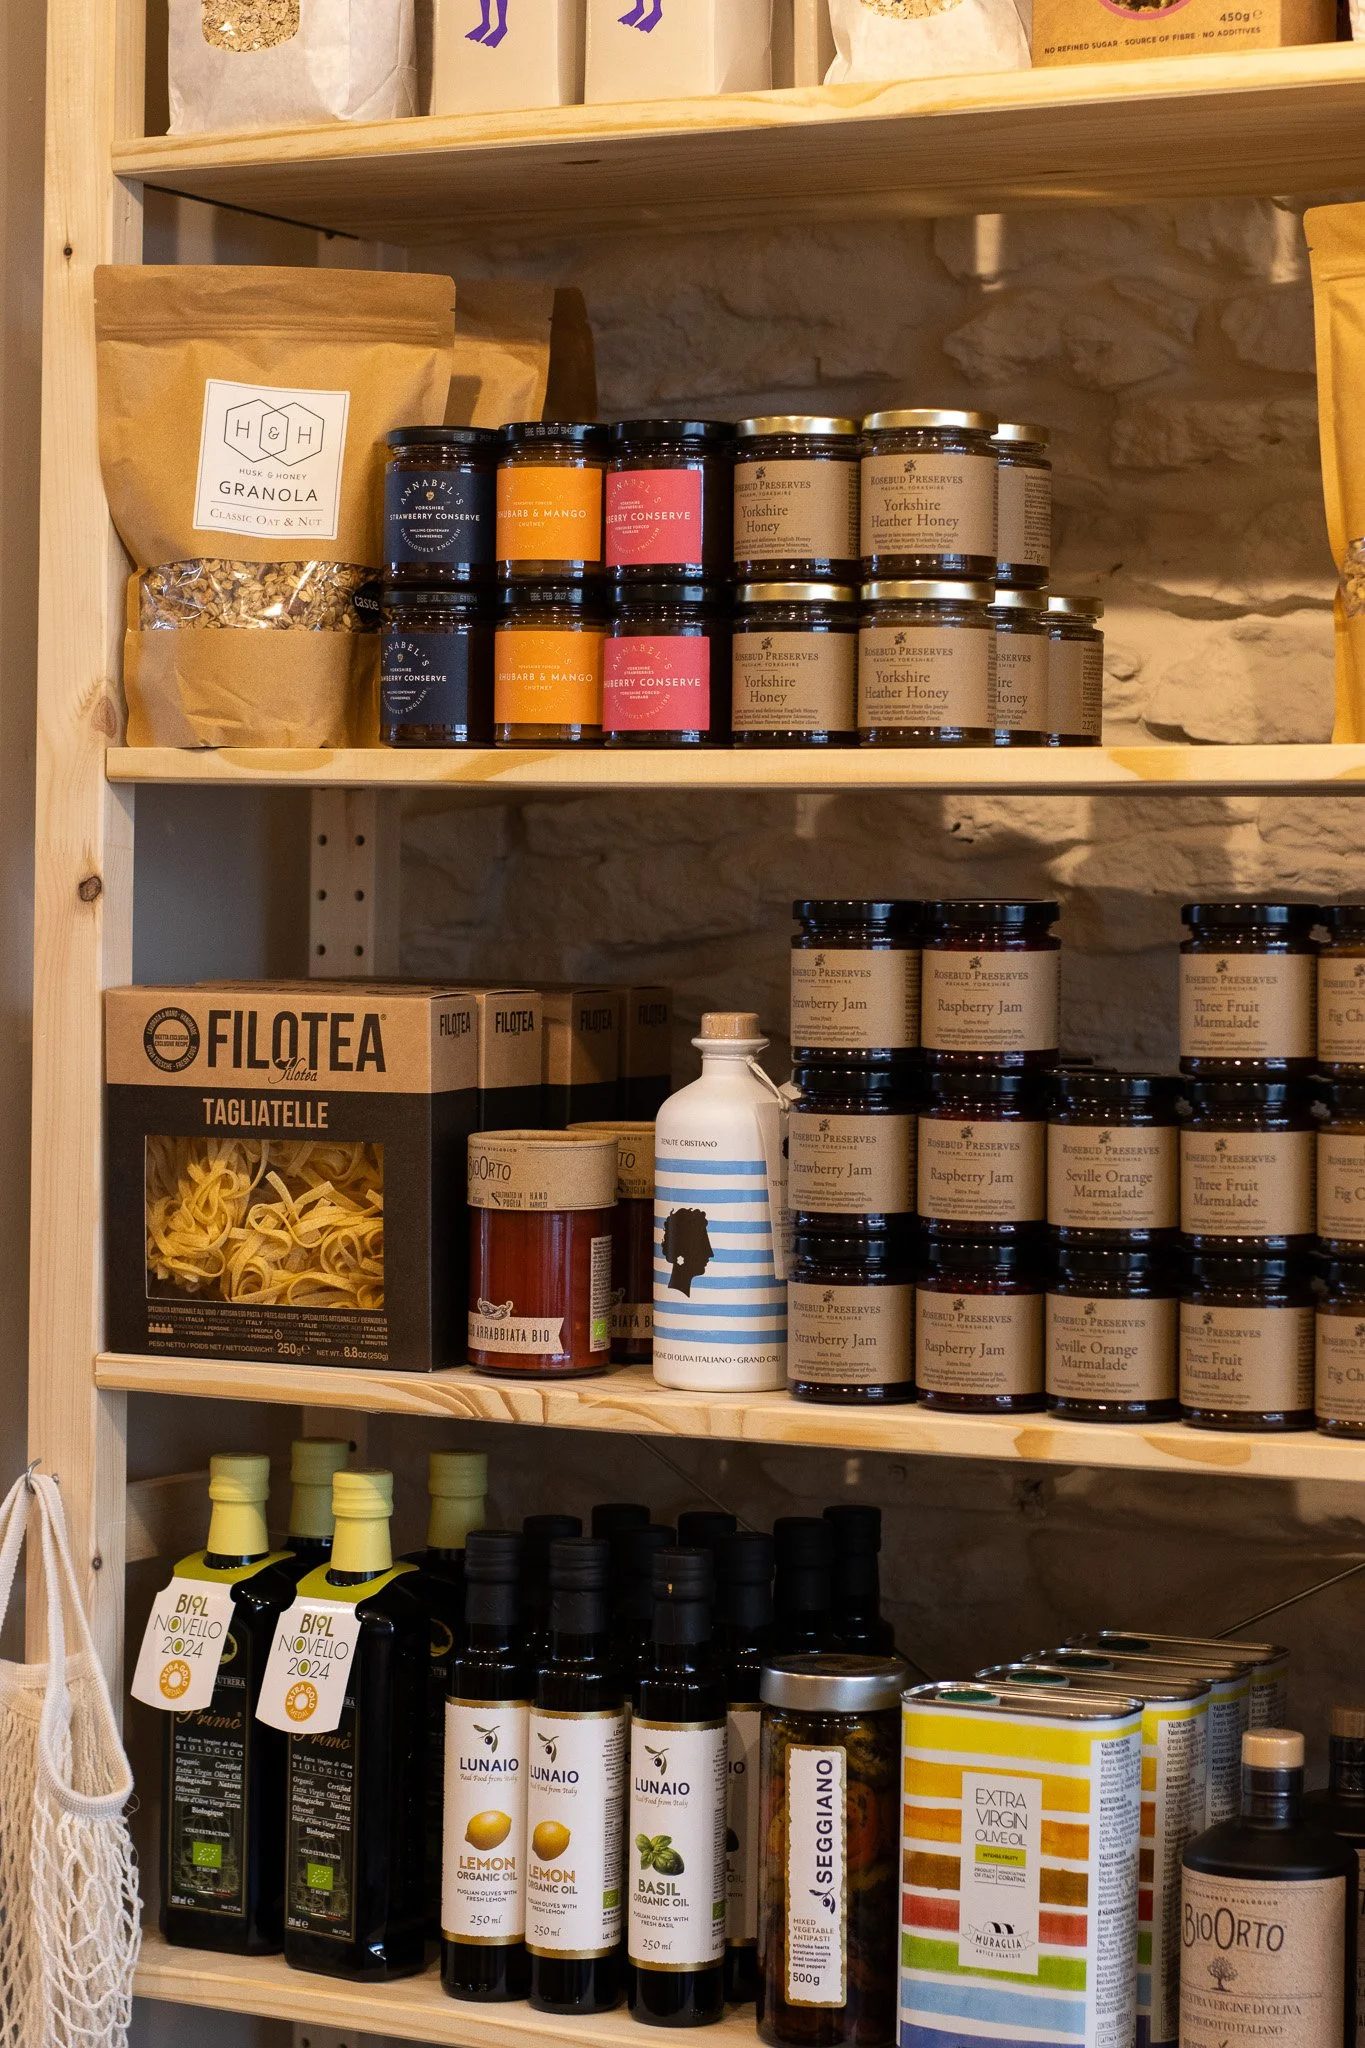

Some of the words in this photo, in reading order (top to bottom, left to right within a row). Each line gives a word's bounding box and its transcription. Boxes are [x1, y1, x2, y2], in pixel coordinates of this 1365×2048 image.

[1220, 12, 1250, 23] 450g
[1058, 44, 1089, 52] REFINED
[1092, 41, 1118, 49] SUGAR
[1125, 37, 1157, 46] SOURCE
[1173, 33, 1195, 41] FIBRE
[1218, 27, 1261, 36] ADDITIVES
[235, 421, 250, 439] H
[268, 427, 279, 440] &
[297, 427, 312, 444] H
[239, 469, 262, 477] HUSK
[276, 472, 306, 480] HONEY
[219, 481, 318, 502] GRANOLA
[400, 479, 464, 506] ANNABEL'S
[742, 504, 788, 518] Yorkshire
[884, 498, 941, 511] Yorkshire
[435, 513, 480, 521] CONSERVE
[544, 510, 587, 519] MANGO
[631, 512, 690, 520] CONSERVE
[872, 515, 913, 527] Heather
[917, 514, 959, 530] Honey
[284, 518, 293, 527] &
[747, 520, 780, 534] Honey
[551, 673, 593, 681] MANGO
[640, 678, 701, 686] CONSERVE
[745, 675, 795, 687] Yorkshire
[876, 671, 930, 683] Yorkshire
[750, 690, 787, 705] Honey
[865, 686, 902, 699] Heather
[907, 686, 949, 702] Honey
[843, 998, 867, 1010] Jam
[938, 999, 994, 1015] Raspberry
[998, 1001, 1022, 1012] Jam
[1193, 1000, 1224, 1012] Three
[1227, 1000, 1259, 1013] Fruit
[440, 1012, 471, 1036] FILOTEA
[495, 1011, 534, 1033] FILOTEA
[1193, 1015, 1260, 1028] Marmalade
[208, 1009, 386, 1072] FILOTEA
[202, 1097, 329, 1131] TAGLIATELLE
[661, 1138, 678, 1146] TENUTE
[793, 1161, 843, 1178] Strawberry
[848, 1164, 872, 1177] Jam
[931, 1168, 985, 1183] Raspberry
[989, 1170, 1013, 1183] Jam
[1066, 1169, 1101, 1181] Seville
[1106, 1169, 1152, 1185] Orange
[1073, 1185, 1143, 1198] Marmalade
[1193, 1177, 1224, 1191] Three
[1226, 1178, 1258, 1192] Fruit
[1193, 1193, 1258, 1208] Marmalade
[1335, 1186, 1352, 1202] Fig
[476, 1325, 526, 1342] ARRABBIATA
[532, 1330, 549, 1342] BIO
[794, 1331, 847, 1348] Strawberry
[852, 1334, 877, 1346] Jam
[278, 1343, 301, 1356] 250g
[925, 1339, 976, 1355] Raspberry
[979, 1343, 1005, 1356] Jam
[1090, 1341, 1138, 1358] Orange
[695, 1355, 731, 1364] ITALIANO
[1061, 1356, 1128, 1371] Marmalade
[1212, 1351, 1242, 1365] Fruit
[1185, 1366, 1242, 1381] Marmalade
[1328, 1366, 1343, 1383] Fig
[154, 1615, 222, 1639] NOVELLO
[162, 1636, 204, 1658] 2024
[278, 1634, 349, 1660] NOVELLO
[161, 1663, 178, 1683] EXTRA
[179, 1665, 188, 1687] GOLD
[287, 1657, 330, 1680] 2024
[286, 1685, 305, 1707] EXTRA
[306, 1686, 316, 1708] GOLD
[289, 1708, 309, 1719] MEDAL
[175, 1743, 243, 1756] BIOLOGICO
[176, 1758, 200, 1766] Organic
[215, 1762, 242, 1771] Certified
[460, 1757, 519, 1772] LUNAIO
[530, 1765, 579, 1784] LUNAIO
[635, 1777, 690, 1795] LUNAIO
[976, 1788, 1027, 1809] EXTRA
[816, 1759, 833, 1883] SEGGIANO
[976, 1809, 1028, 1830] VIRGIN
[975, 1829, 1008, 1844] OLIVE
[1008, 1832, 1027, 1846] OIL
[459, 1856, 516, 1870] LEMON
[456, 1871, 500, 1882] ORGANIC
[502, 1872, 517, 1881] OIL
[529, 1864, 576, 1883] LEMON
[561, 1885, 578, 1894] OIL
[638, 1879, 680, 1896] BASIL
[633, 1892, 671, 1907] ORGANIC
[673, 1898, 689, 1907] OIL
[794, 1926, 834, 1934] VEGETABLE
[976, 1935, 1021, 1948] MURAGLIA
[793, 1972, 820, 1986] 500g
[1209, 1998, 1251, 2014] VERGINE
[1253, 2005, 1265, 2014] DI
[1268, 2006, 1302, 2015] OLIVA
[1237, 2023, 1283, 2034] ITALIANO
